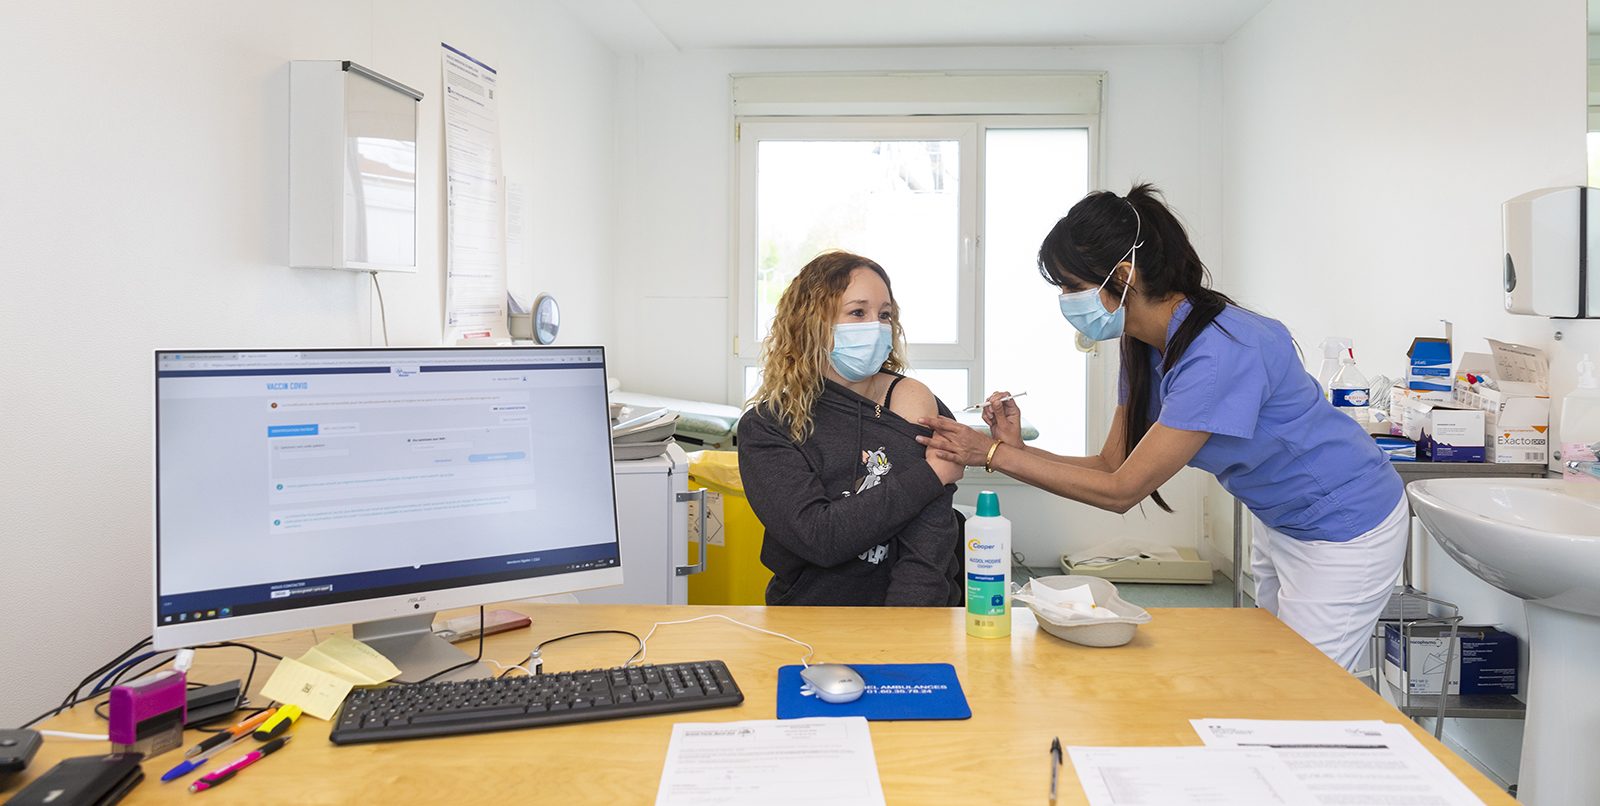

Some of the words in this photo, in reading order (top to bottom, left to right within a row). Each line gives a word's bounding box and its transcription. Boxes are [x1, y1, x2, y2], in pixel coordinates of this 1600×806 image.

[266, 382, 289, 391] VACCIN
[290, 381, 308, 390] COVID
[1497, 435, 1531, 445] Exacto
[972, 542, 996, 550] Cooper
